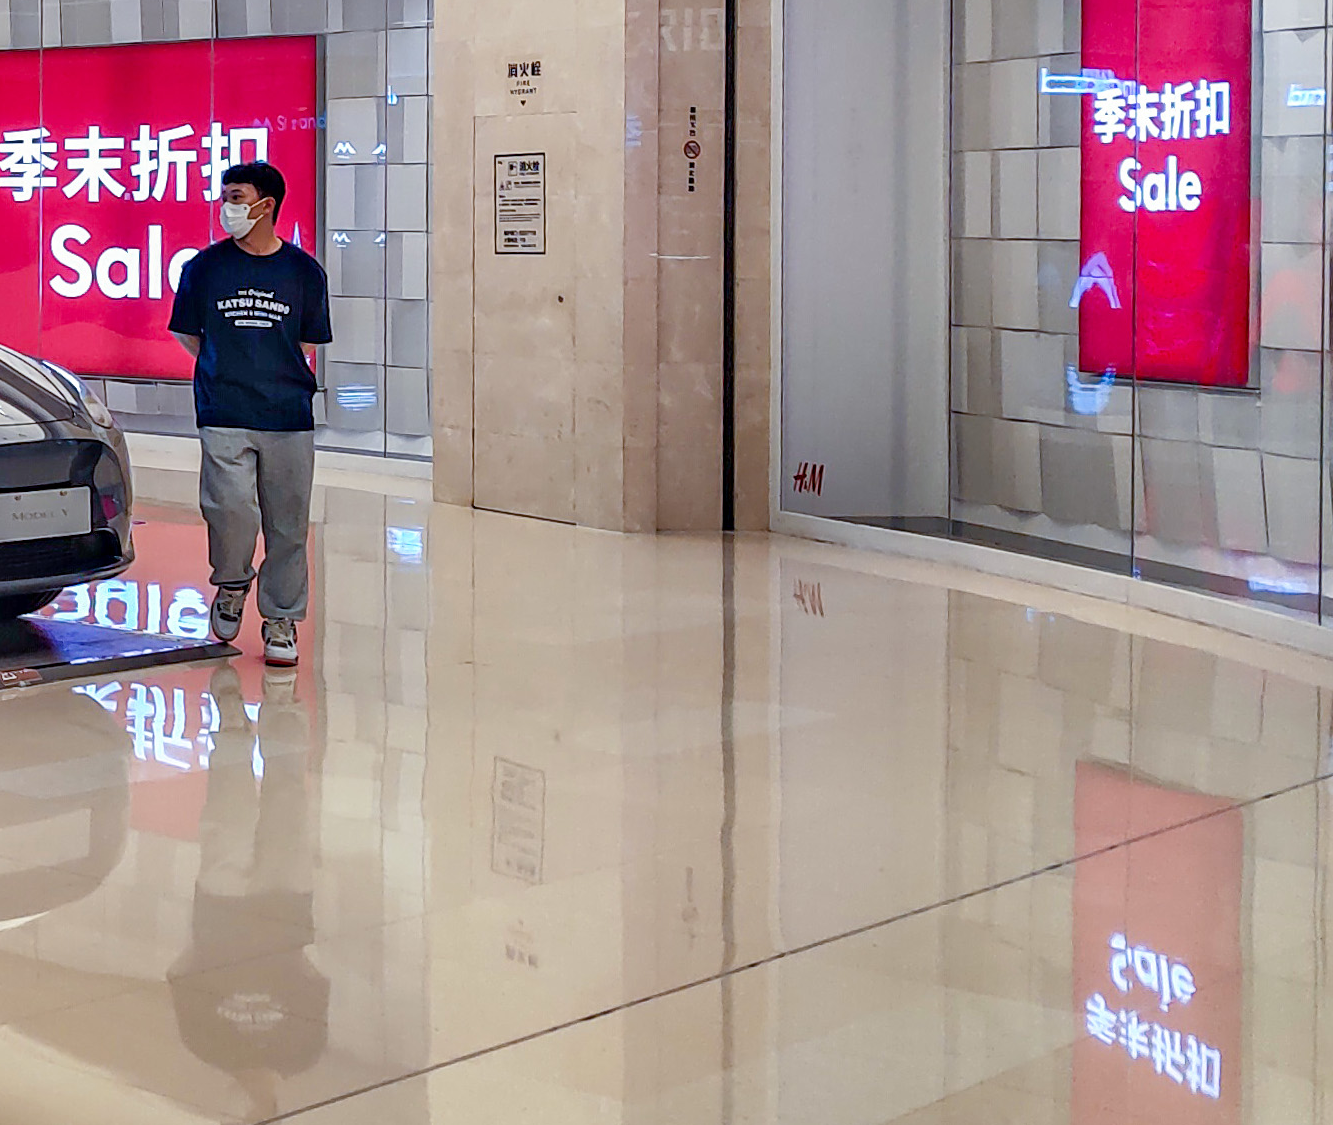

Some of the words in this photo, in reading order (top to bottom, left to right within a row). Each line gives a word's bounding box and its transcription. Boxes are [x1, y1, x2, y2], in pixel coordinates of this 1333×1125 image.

[1093, 79, 1230, 144] 季末折扣
[1118, 155, 1202, 213] Sale
[216, 297, 254, 310] KATSU
